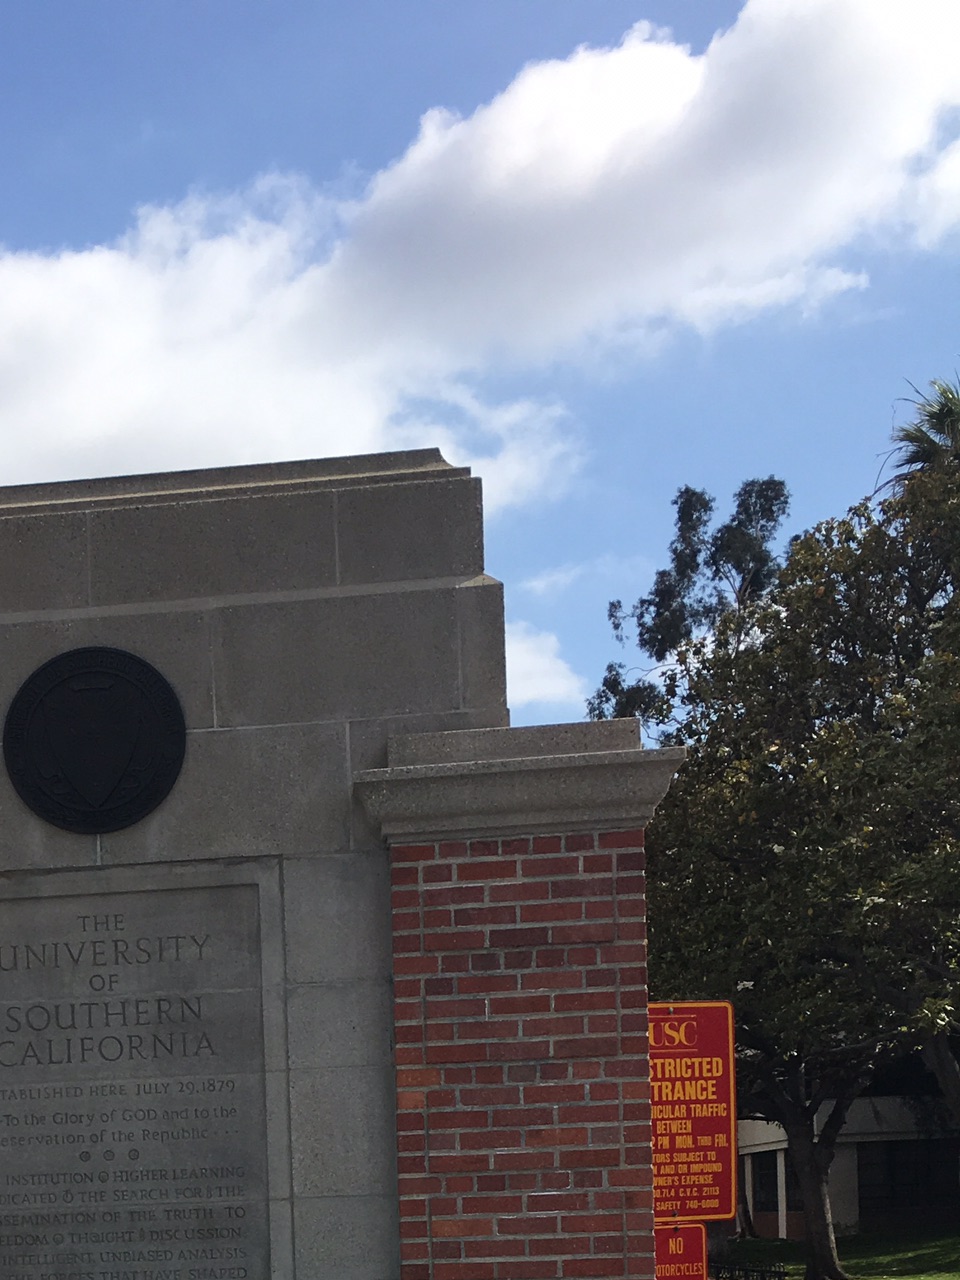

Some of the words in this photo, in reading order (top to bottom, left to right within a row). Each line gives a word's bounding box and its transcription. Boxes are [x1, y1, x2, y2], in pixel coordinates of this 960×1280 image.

[77, 913, 126, 932] THE
[88, 973, 119, 992] OF
[4, 996, 203, 1033] SOUTHERN
[648, 1020, 698, 1047] USC
[90, 1084, 127, 1097] HERE
[135, 1082, 170, 1096] JULY
[3, 1113, 20, 1126] To
[24, 1112, 47, 1126] the
[52, 1111, 95, 1127] Glory
[100, 1109, 117, 1123] of
[122, 1108, 158, 1122] GOD
[162, 1107, 189, 1120] and
[193, 1107, 209, 1119] to
[213, 1105, 238, 1118] the
[690, 1103, 727, 1117] TRAFFIC
[90, 1128, 107, 1143] of
[111, 1129, 135, 1142] the
[142, 1126, 209, 1143] Republic
[656, 1120, 692, 1134] BETWEEN
[657, 1135, 670, 1149] PM
[675, 1135, 695, 1149] MON.
[714, 1133, 728, 1148] FRI.
[673, 1151, 705, 1162] SUBJECT
[707, 1151, 716, 1161] TO
[690, 1162, 722, 1173] IMPOUND
[6, 1171, 94, 1186] INSTITUTION
[113, 1168, 168, 1182] HIGHER
[171, 1166, 246, 1180] LEARNING
[681, 1174, 714, 1185] EXPENSE
[78, 1190, 107, 1203] THE
[113, 1188, 169, 1201] SEARCH
[175, 1186, 202, 1200] FOR
[215, 1185, 245, 1198] THE
[679, 1187, 700, 1197] C.V.C.
[656, 1201, 681, 1211] SAFETY
[102, 1210, 120, 1223] OF
[127, 1210, 156, 1222] THE
[163, 1208, 214, 1221] TRUTH
[223, 1206, 246, 1219] TO
[668, 1237, 684, 1255] NO
[100, 1250, 173, 1264] UNBIASED
[177, 1247, 248, 1260] ANALYSIS
[188, 1267, 248, 1280] SHAPED
[656, 1262, 704, 1277] OTORCYCLES
